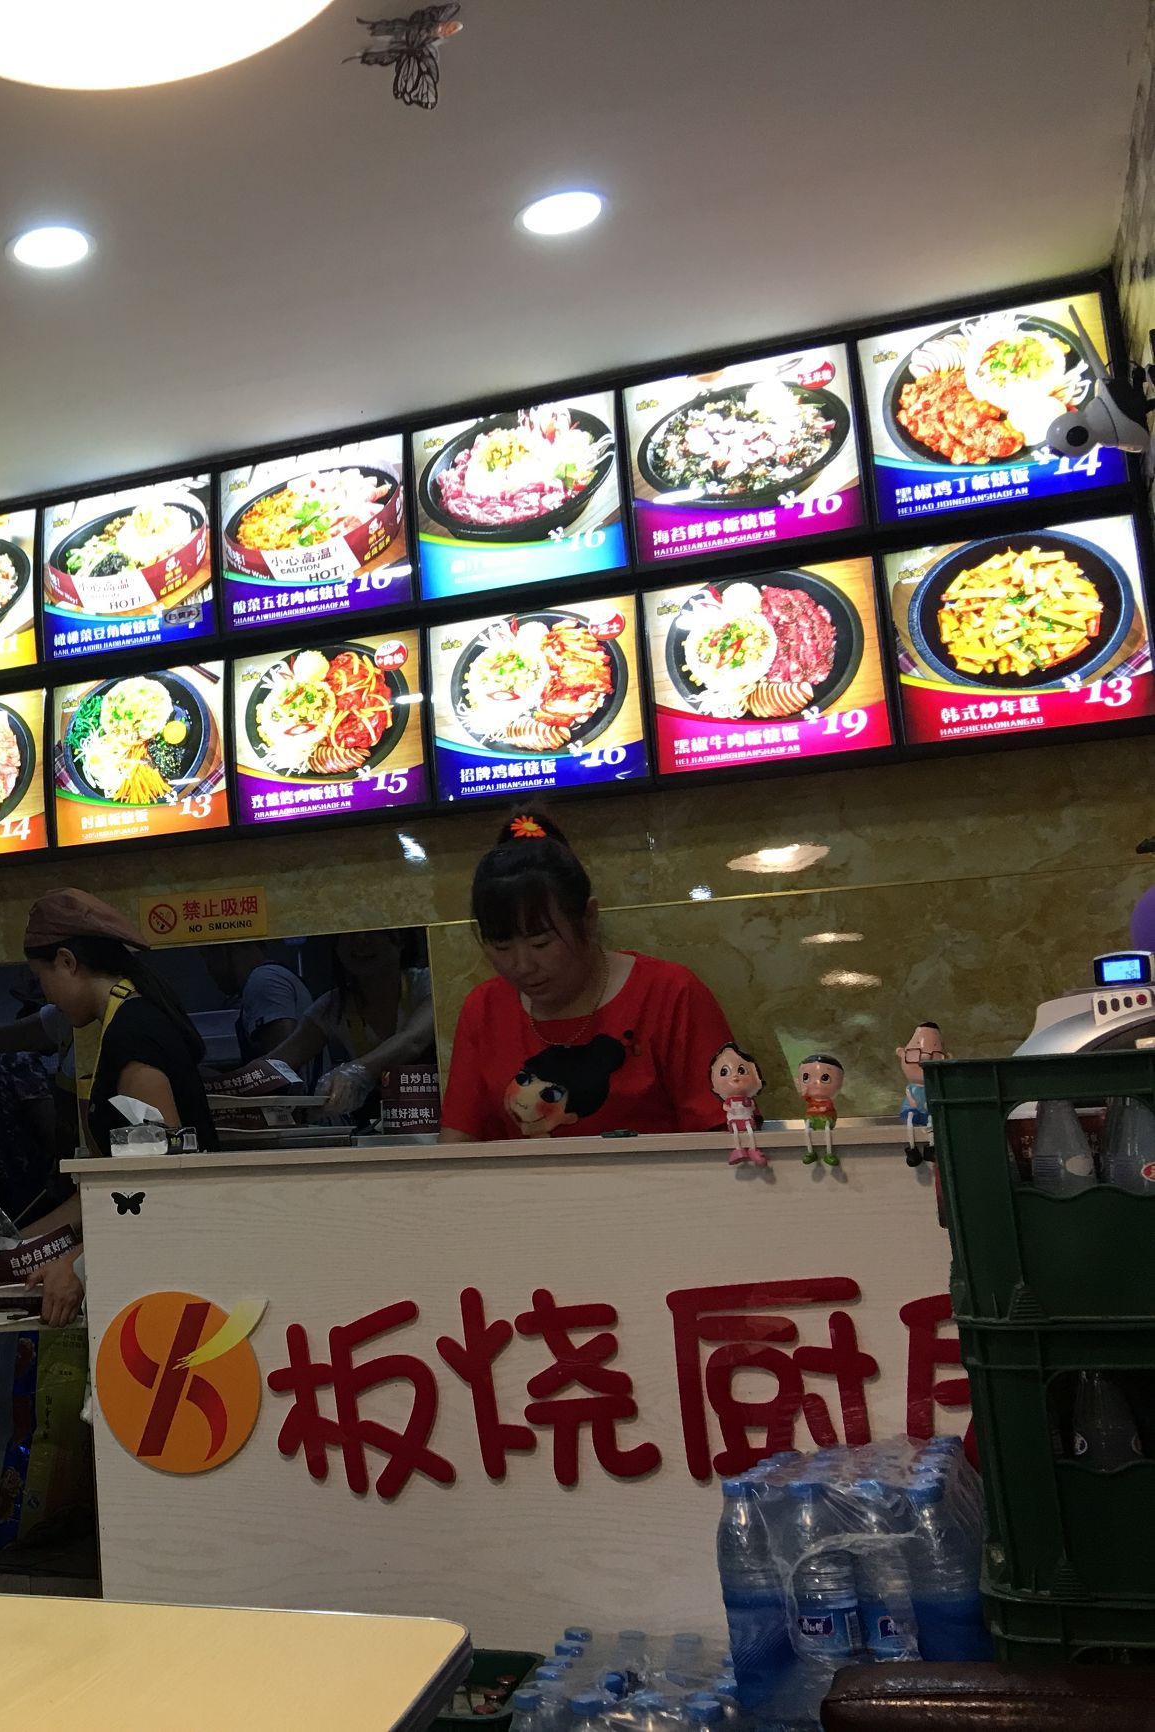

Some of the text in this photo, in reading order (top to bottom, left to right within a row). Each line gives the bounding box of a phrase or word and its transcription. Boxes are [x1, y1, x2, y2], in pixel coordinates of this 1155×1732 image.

[280, 563, 321, 575] CAUTION
[233, 583, 349, 615] 酸菜五花肉板烧饭
[940, 696, 1040, 724] 韩式炒年糕
[940, 716, 1044, 737] HANSHICHAONIANGAO
[674, 724, 800, 755] 黑椒牛肉板烧饭
[459, 758, 557, 783] 招牌鸡板烧饭
[182, 896, 258, 921] 禁止吸烟
[189, 920, 252, 933] NO SMOKING
